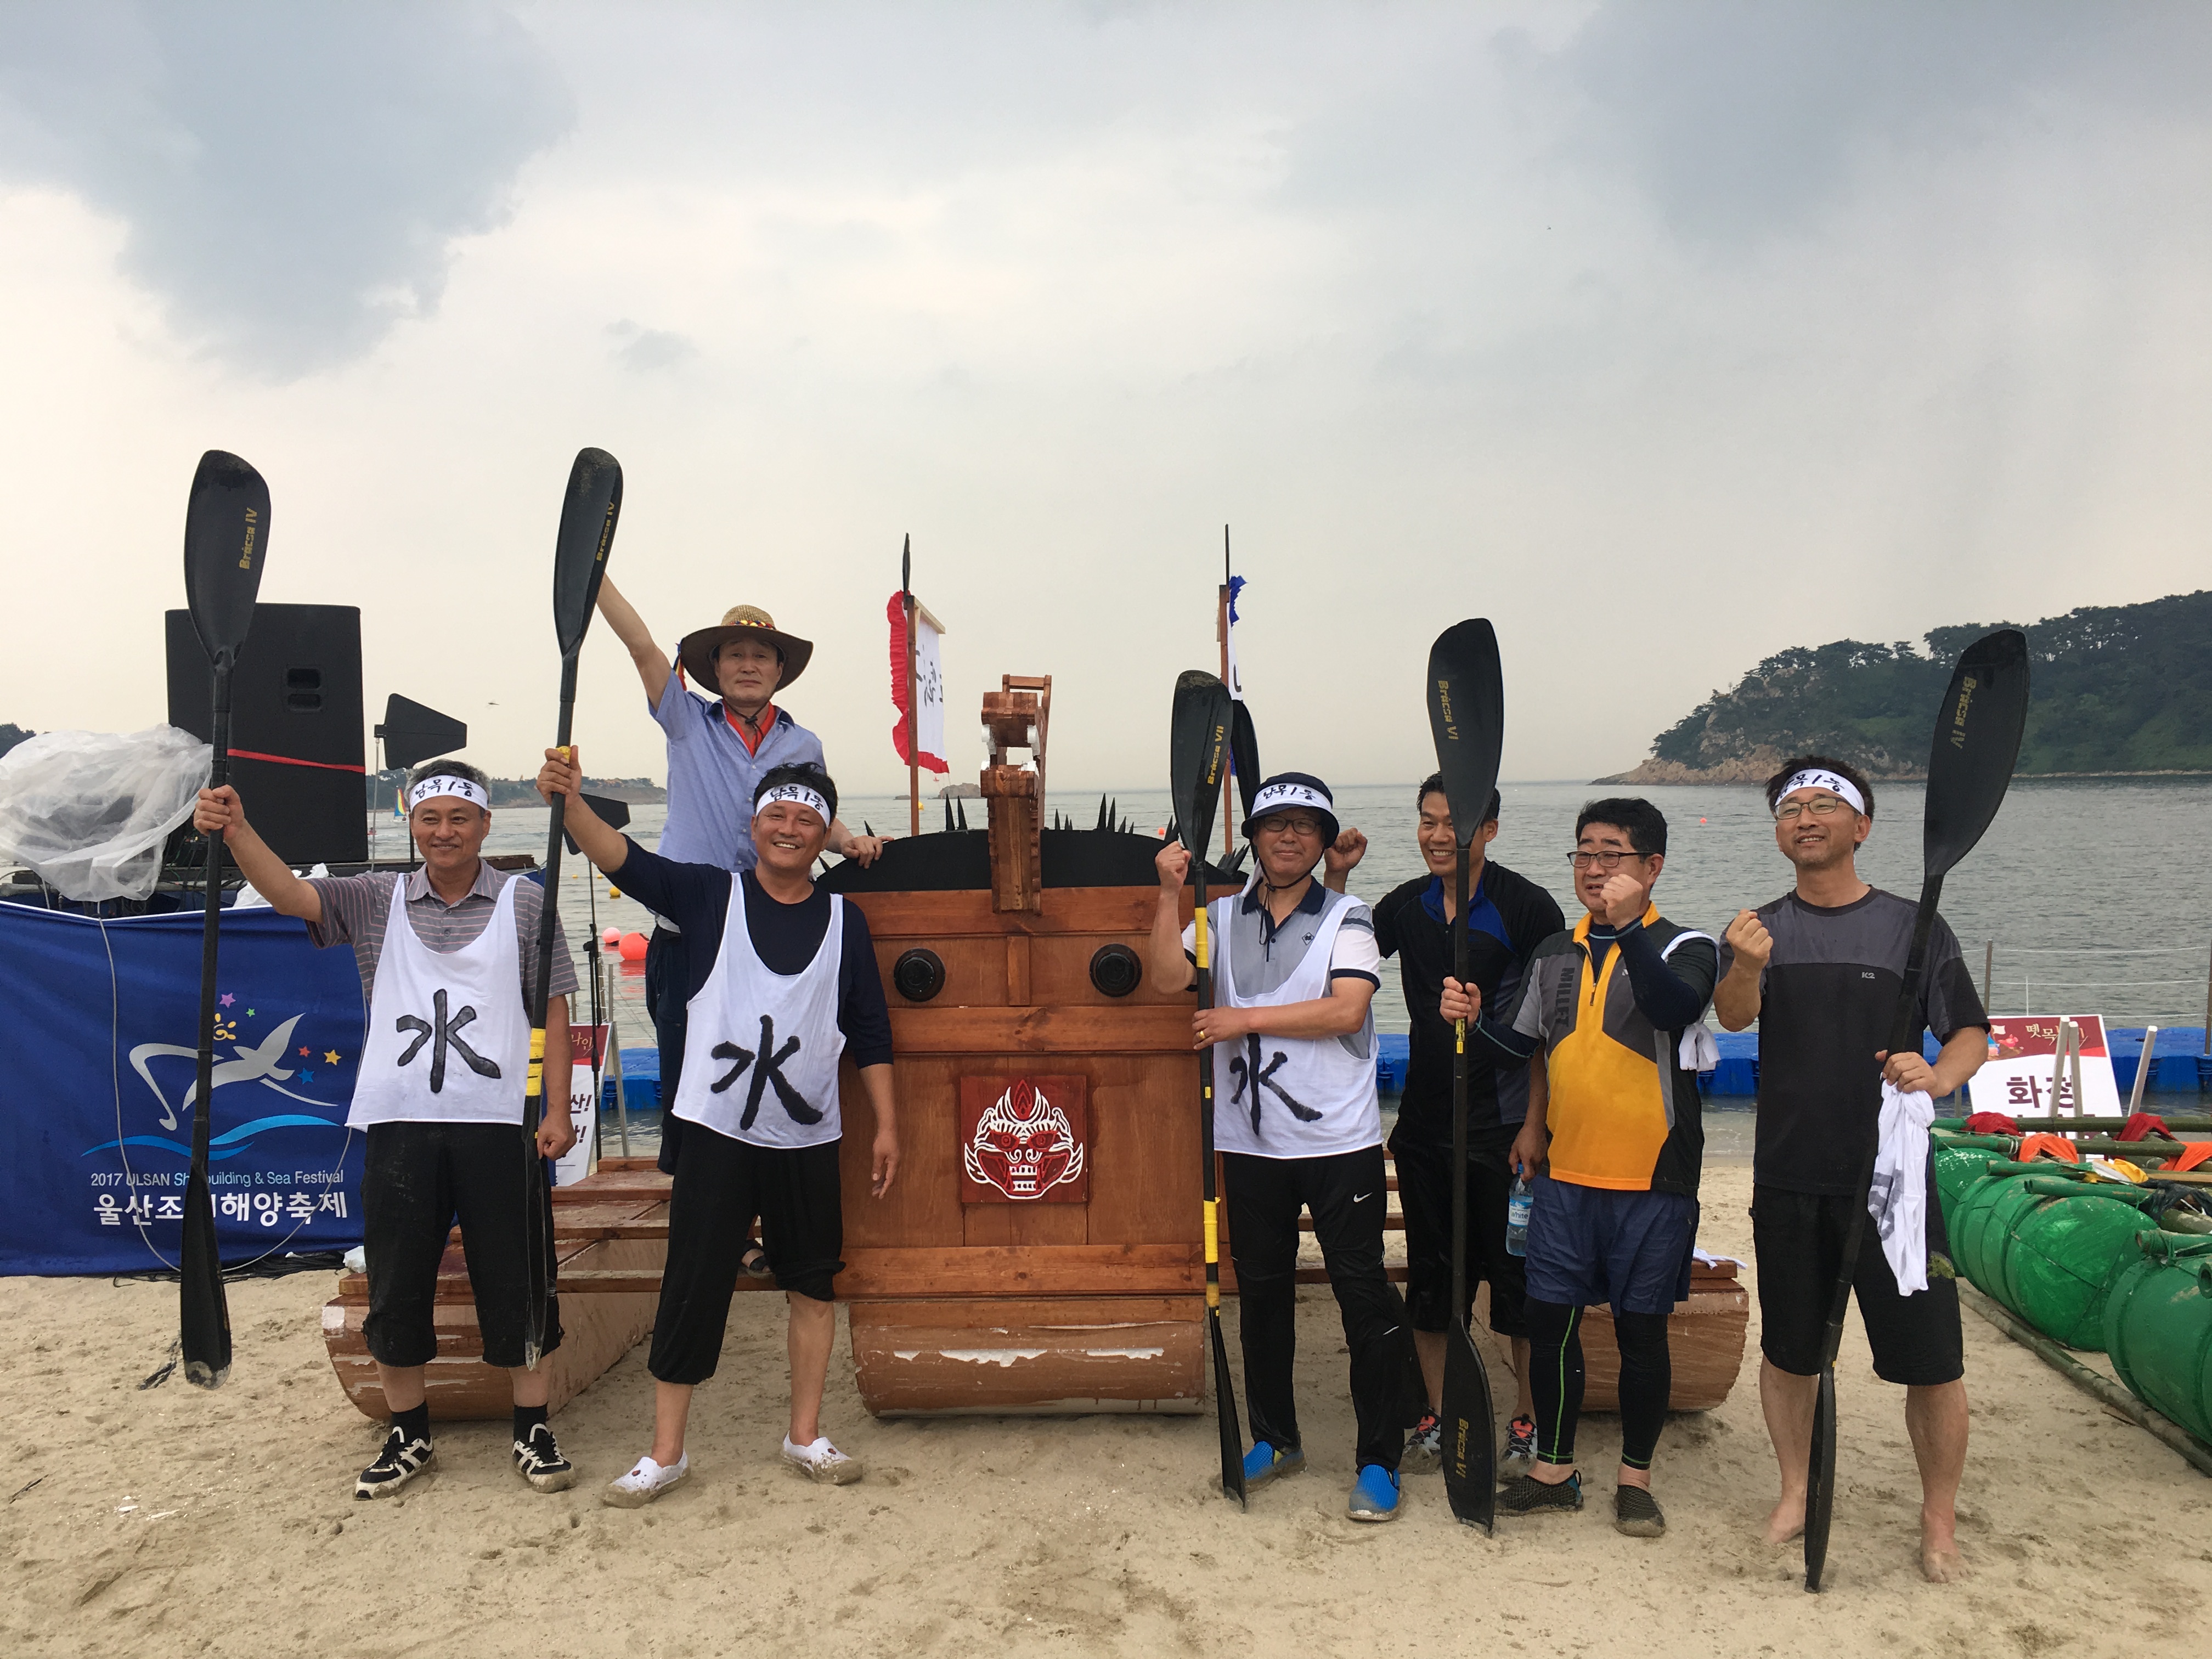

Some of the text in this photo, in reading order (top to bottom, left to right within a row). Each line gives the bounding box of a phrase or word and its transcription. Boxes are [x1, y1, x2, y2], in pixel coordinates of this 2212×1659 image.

[245, 507, 257, 523] IV
[607, 501, 614, 515] IV
[1215, 725, 1224, 742] VII
[1447, 726, 1458, 740] VI
[1950, 730, 1966, 749] IV
[396, 989, 501, 1093] 水
[710, 1014, 823, 1131] 水
[1229, 1033, 1323, 1136] 水
[91, 1170, 343, 1187] 2017 ULSAN Shuilding & Sea Festival
[1456, 1463, 1466, 1479] VI
